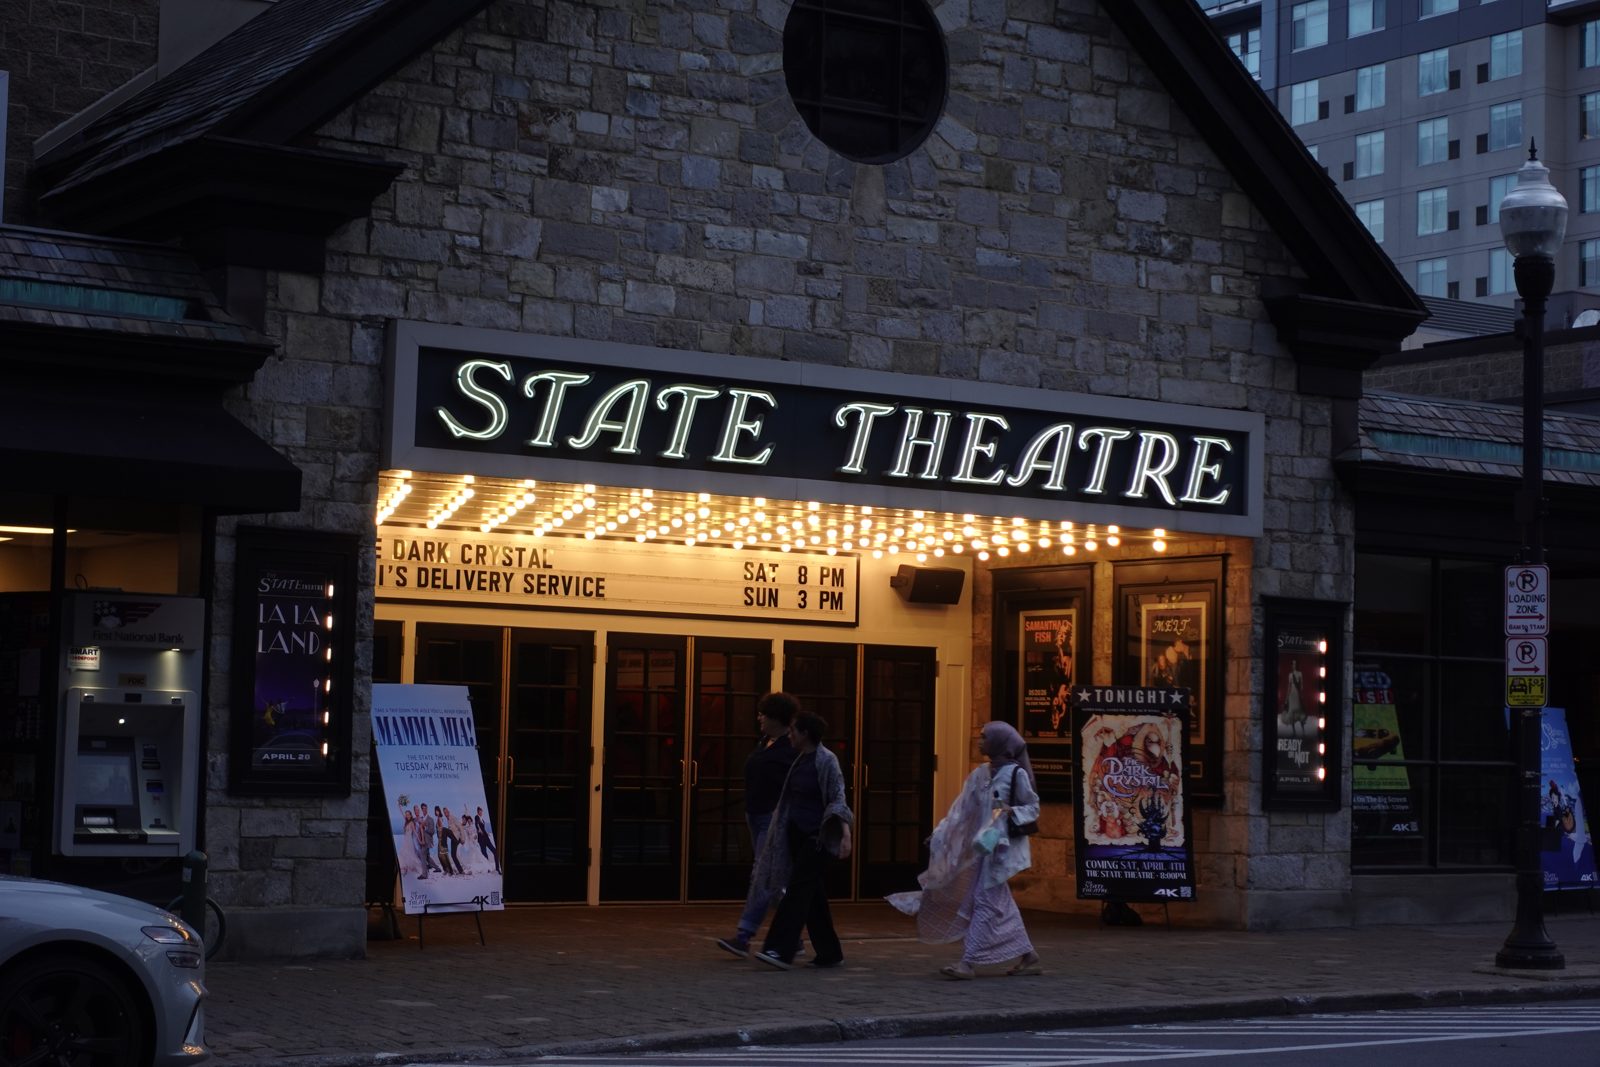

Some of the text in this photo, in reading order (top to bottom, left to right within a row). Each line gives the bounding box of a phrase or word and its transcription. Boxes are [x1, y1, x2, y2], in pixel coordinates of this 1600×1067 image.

[436, 358, 1233, 507] STATE THEATRE
[392, 538, 450, 564] DARK
[460, 543, 554, 569] CRYSTAL
[416, 566, 515, 594] DELIVERY
[522, 572, 606, 598] SERVICE
[743, 561, 845, 588] SAT 8 PM
[743, 586, 844, 611] SUN 3 PM
[1508, 594, 1546, 603] LOADING
[259, 602, 320, 626] LA LA
[1516, 605, 1539, 614] ZONE
[1151, 618, 1191, 636] MELT
[92, 630, 185, 643] First National Bank
[257, 628, 320, 655] LAND
[1034, 631, 1052, 643] FISH
[69, 647, 98, 656] SMART
[1094, 688, 1167, 704] TONIGHT
[375, 716, 475, 747] MAMMA MIA!
[1277, 738, 1302, 752] READY
[395, 762, 469, 771] TUESDAY, APRIL 7TH
[1101, 757, 1155, 775] DARK
[1294, 751, 1310, 768] NOT
[1103, 774, 1169, 798] CRYSTAL
[1392, 823, 1410, 831] 4K
[1085, 860, 1119, 870] COMING
[1120, 861, 1140, 872] SAT,
[1142, 862, 1166, 871] APRIL
[1086, 870, 1187, 881] THE STATE THEATRE 8:00PM
[471, 895, 490, 905] 4K
[1153, 888, 1180, 898] 4K
